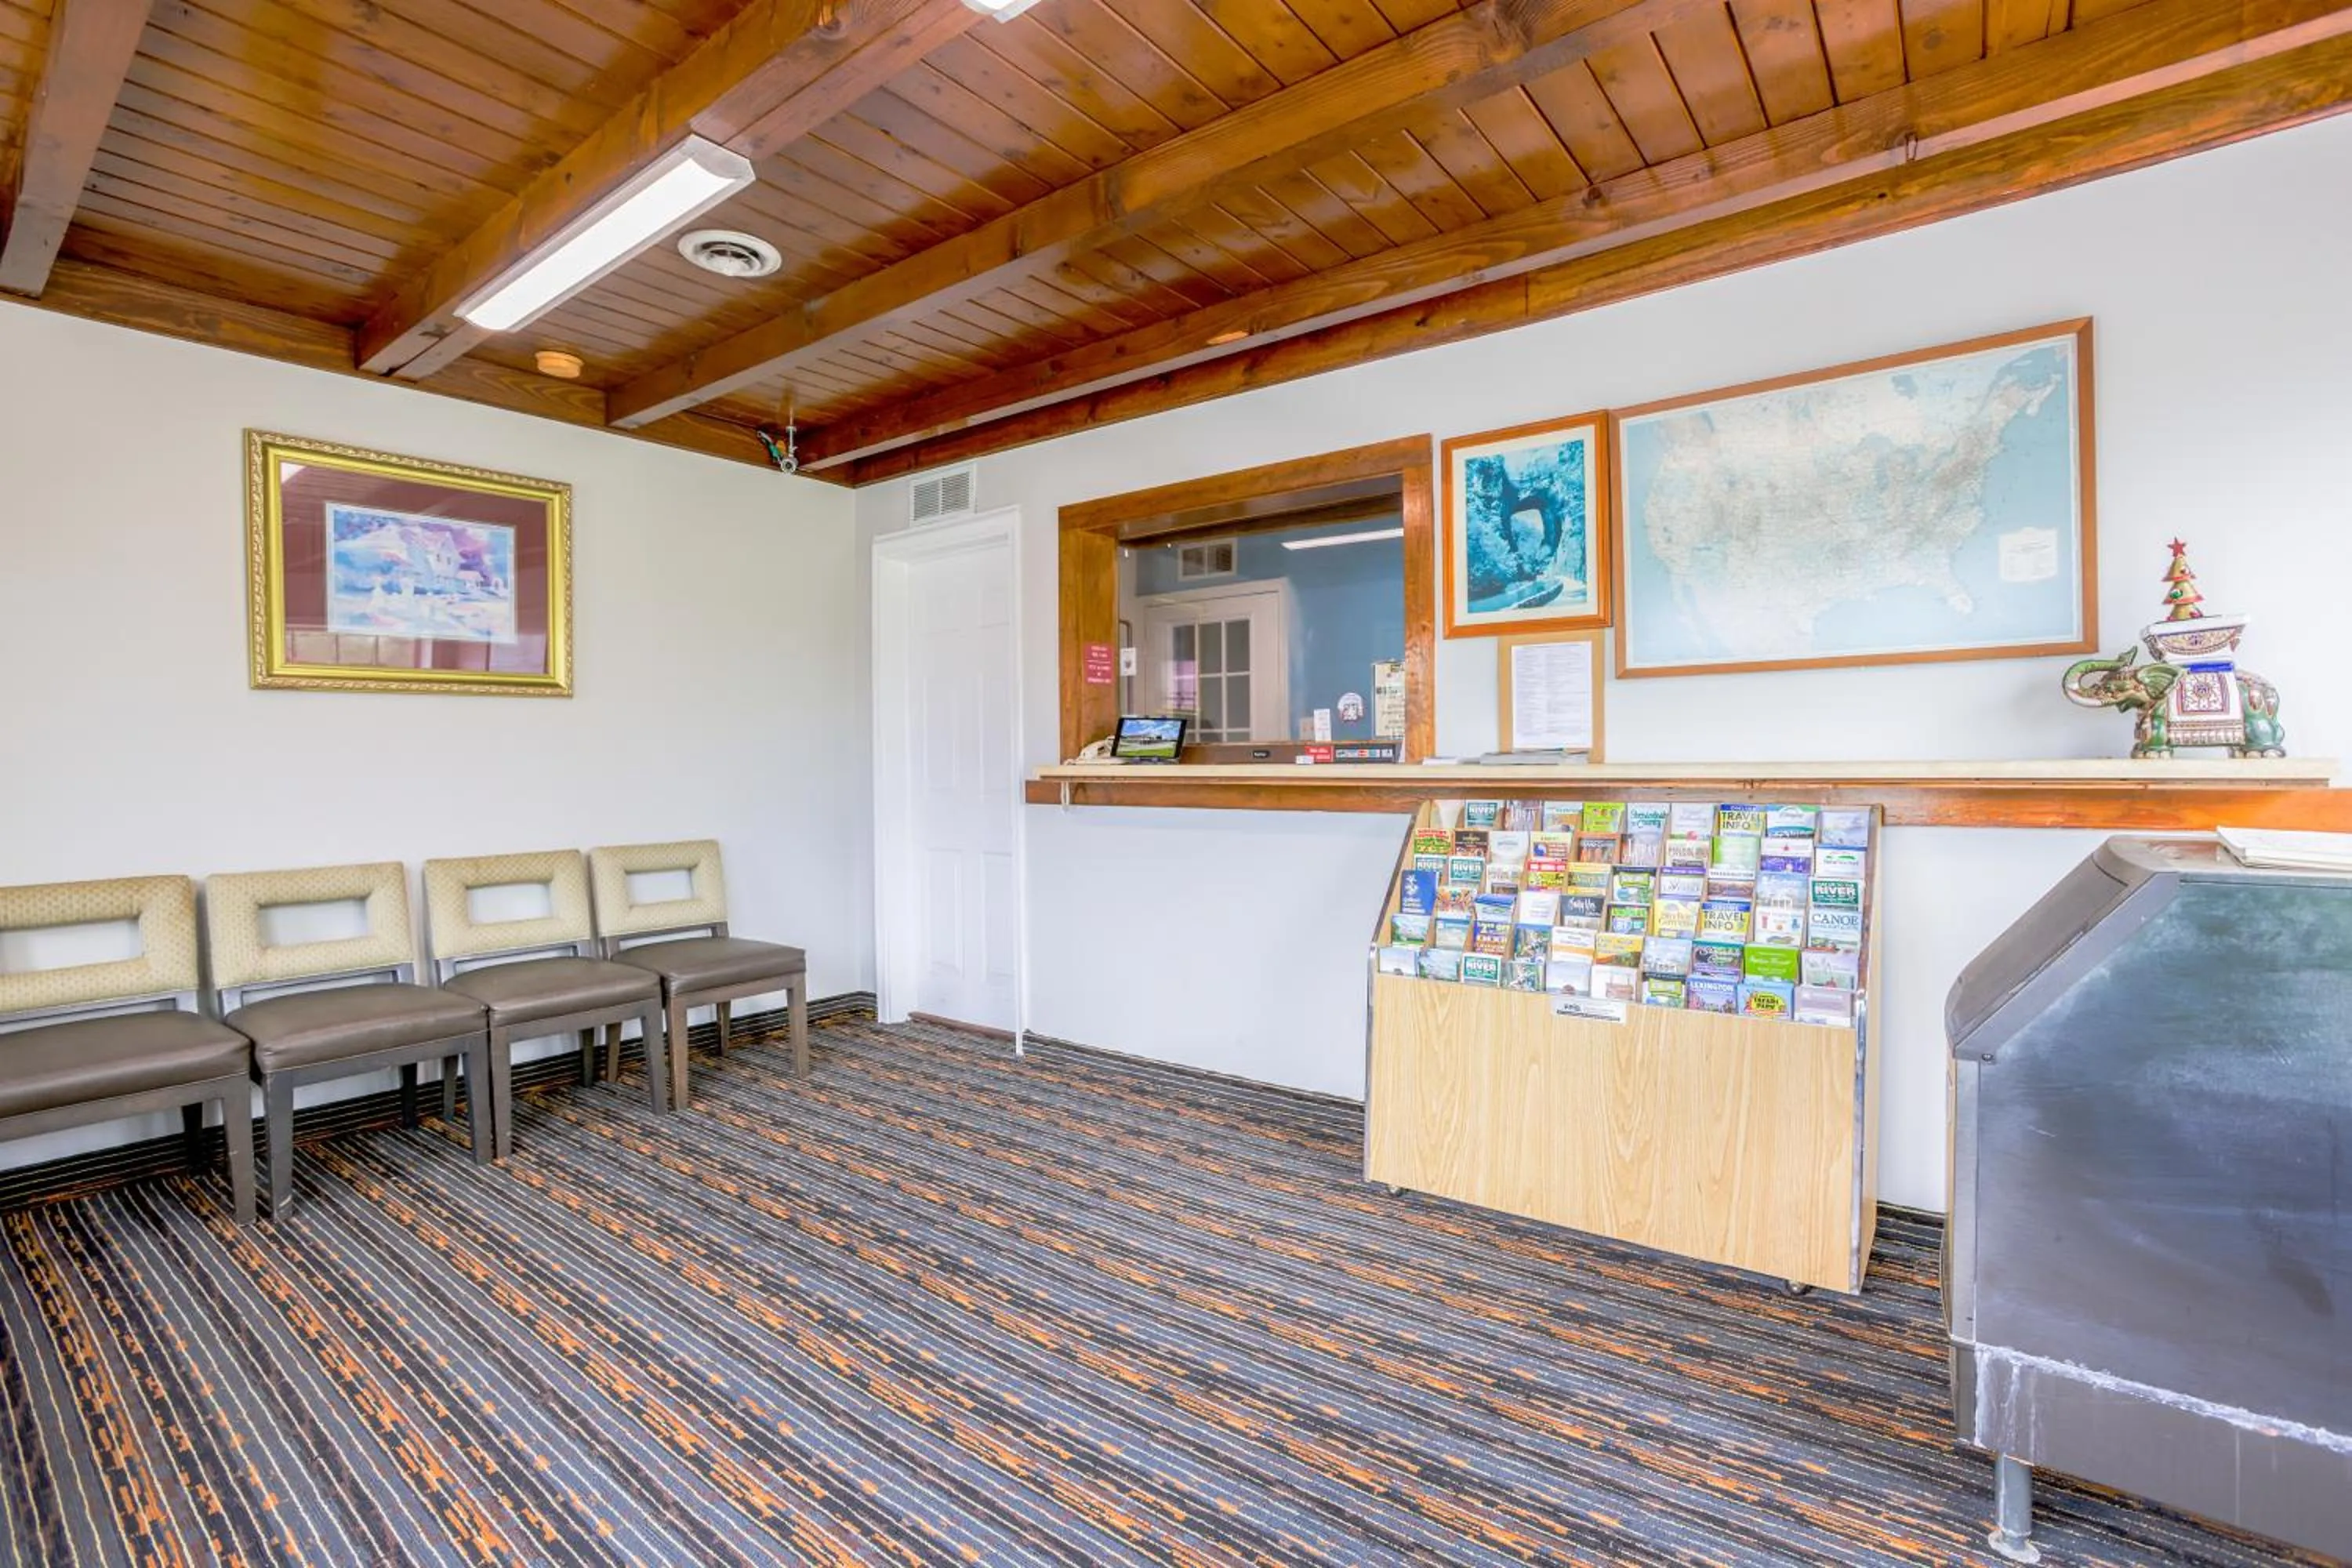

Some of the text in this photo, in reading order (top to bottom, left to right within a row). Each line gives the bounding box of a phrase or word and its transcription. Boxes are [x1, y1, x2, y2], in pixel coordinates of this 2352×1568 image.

[1722, 821, 1751, 830] INFO
[1816, 886, 1857, 897] RIVER
[1704, 910, 1745, 922] TRAVEL
[1812, 913, 1859, 926] CANOE
[1704, 920, 1734, 931] INFO
[1690, 981, 1735, 993] LEXINGTON
